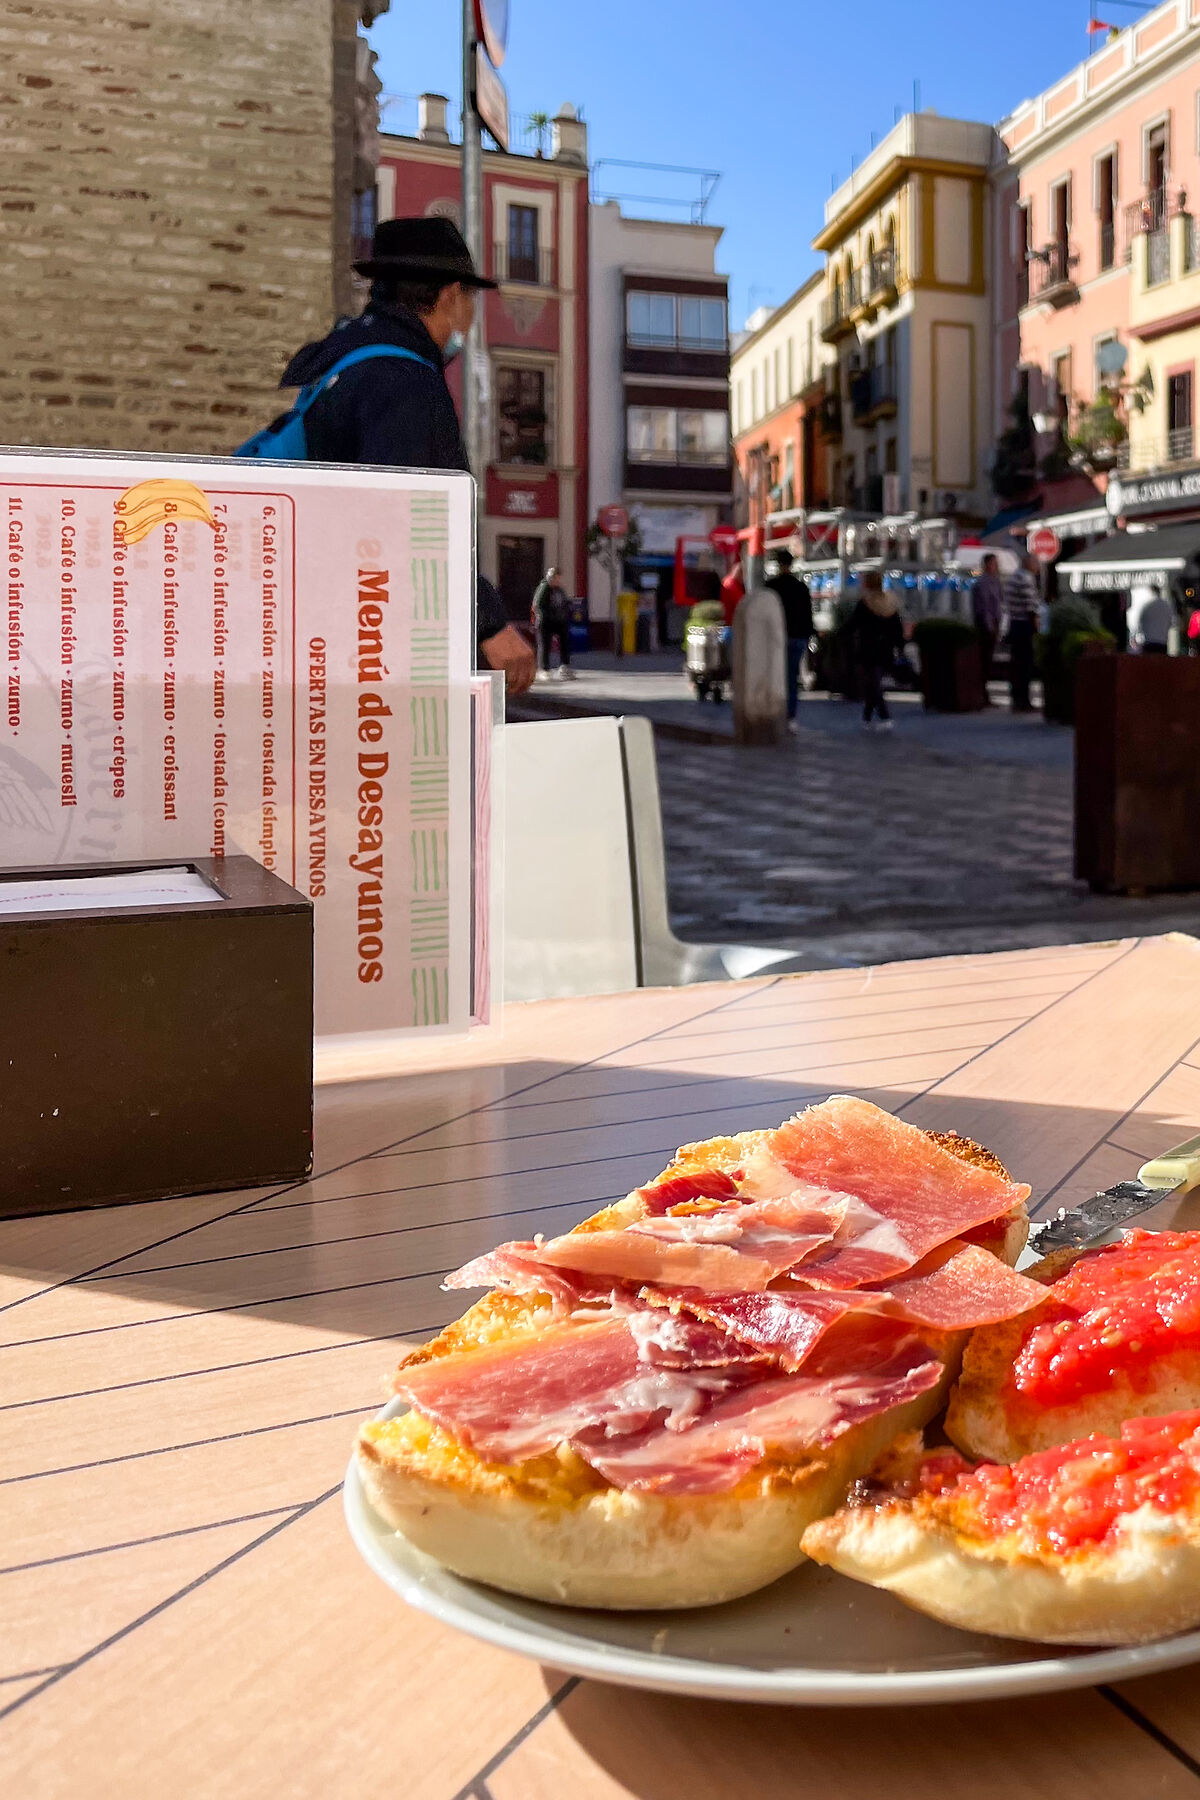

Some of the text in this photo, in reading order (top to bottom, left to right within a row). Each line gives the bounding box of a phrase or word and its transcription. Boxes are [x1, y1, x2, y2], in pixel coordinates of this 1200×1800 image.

[112, 498, 130, 517] 9.
[112, 519, 131, 562] Café
[210, 519, 229, 563] Café
[213, 504, 228, 518] 7.
[112, 565, 125, 577] o
[213, 566, 226, 578] o
[7, 497, 25, 727] 11. Café o infusión zumo
[112, 580, 130, 658] infusión
[213, 581, 230, 657] infusión
[357, 568, 390, 684] Menú
[60, 498, 78, 807] 10. Café o infusión zumo muesli
[161, 501, 180, 821] 8. Café o infusión zumo croissant
[112, 670, 125, 722] zumo
[213, 669, 226, 720] zumo
[260, 505, 278, 871] 6. Café o infusión zumo tostada (simple)
[357, 692, 393, 743] de
[213, 732, 229, 799] tostada
[308, 636, 327, 898] OFERTAS EN DESAYUNOS
[348, 751, 390, 984] Desayunos
